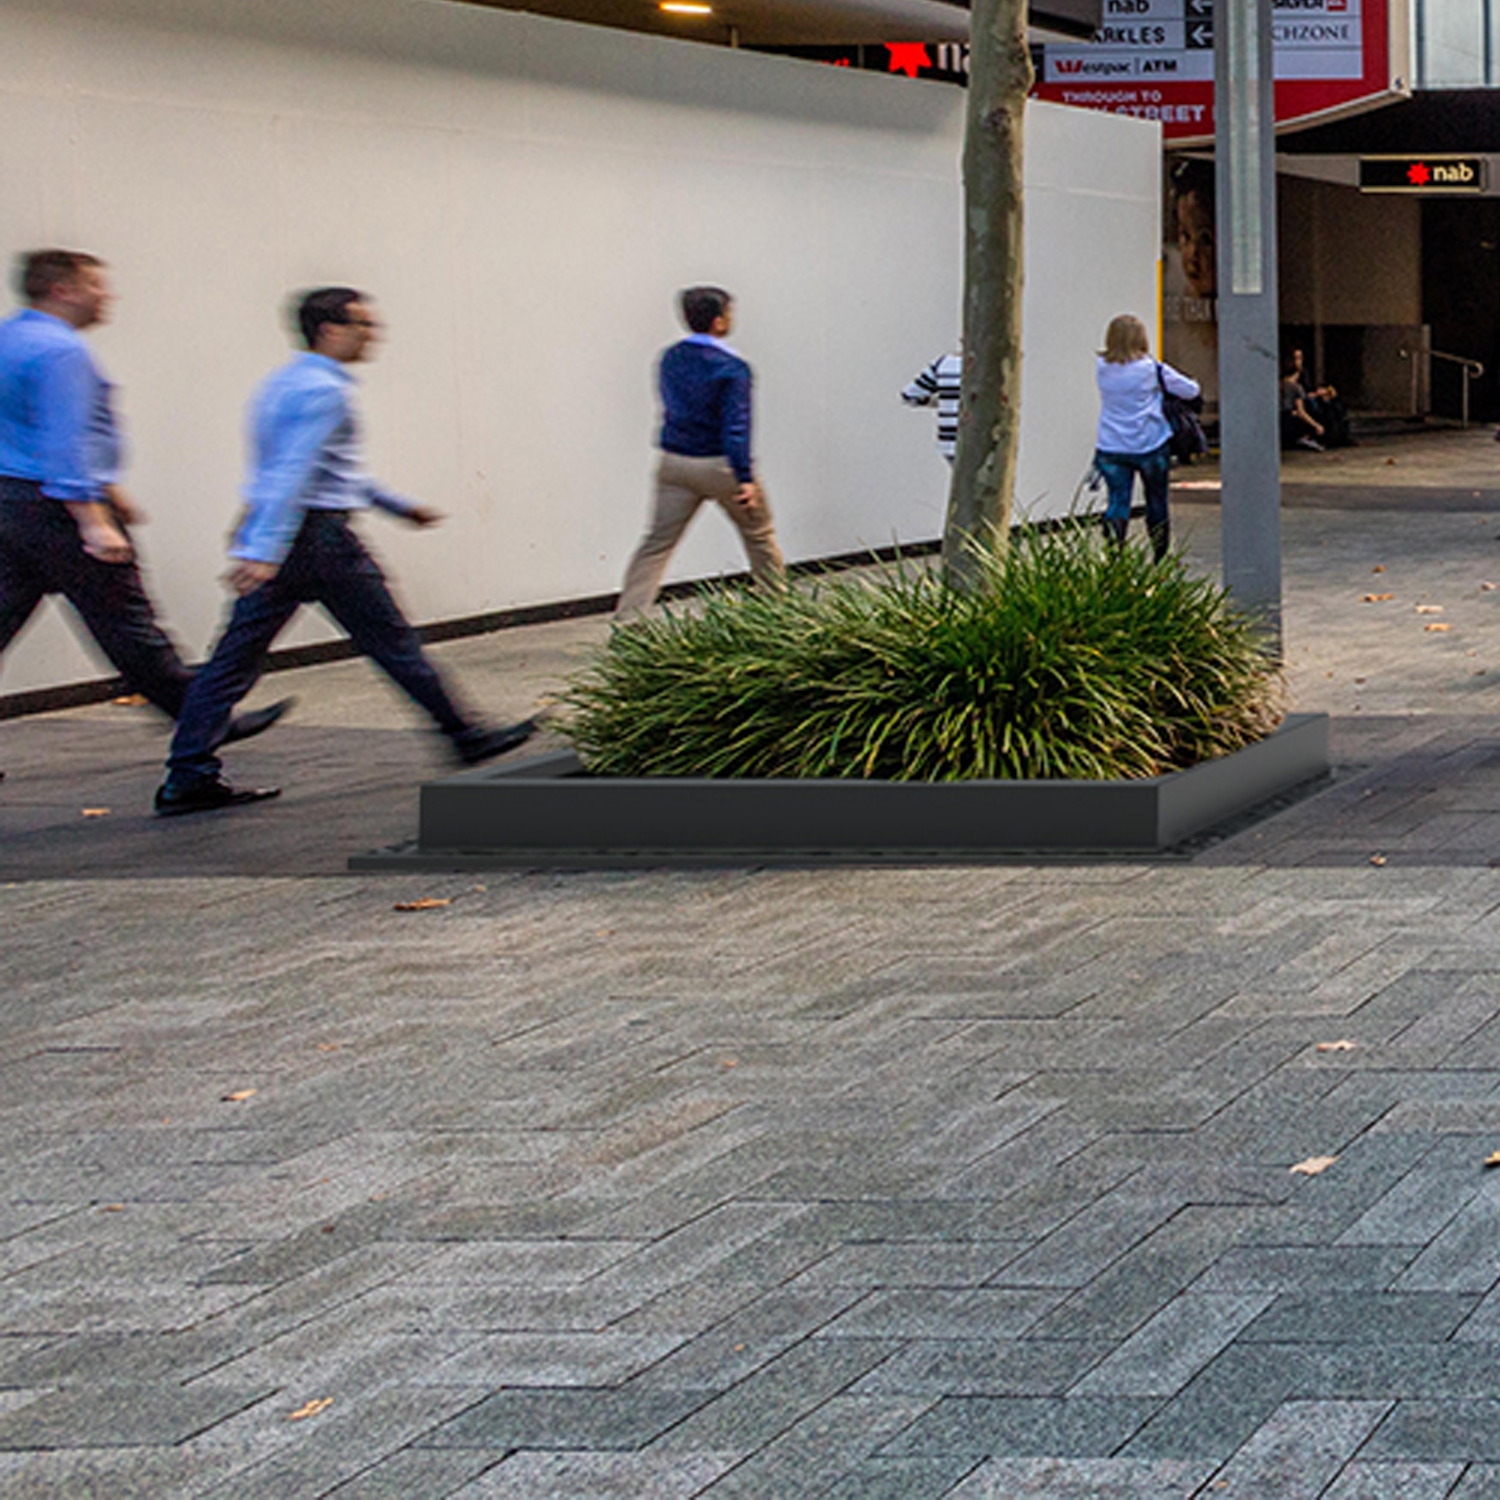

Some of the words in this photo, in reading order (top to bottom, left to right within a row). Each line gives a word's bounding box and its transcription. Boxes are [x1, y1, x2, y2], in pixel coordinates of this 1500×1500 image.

[1272, 24, 1349, 41] CHZONE
[1055, 60, 1131, 75] Westpac
[1142, 60, 1177, 73] ATM
[1062, 90, 1138, 103] THROUGH
[1141, 90, 1162, 103] TO
[1433, 162, 1474, 182] nab
